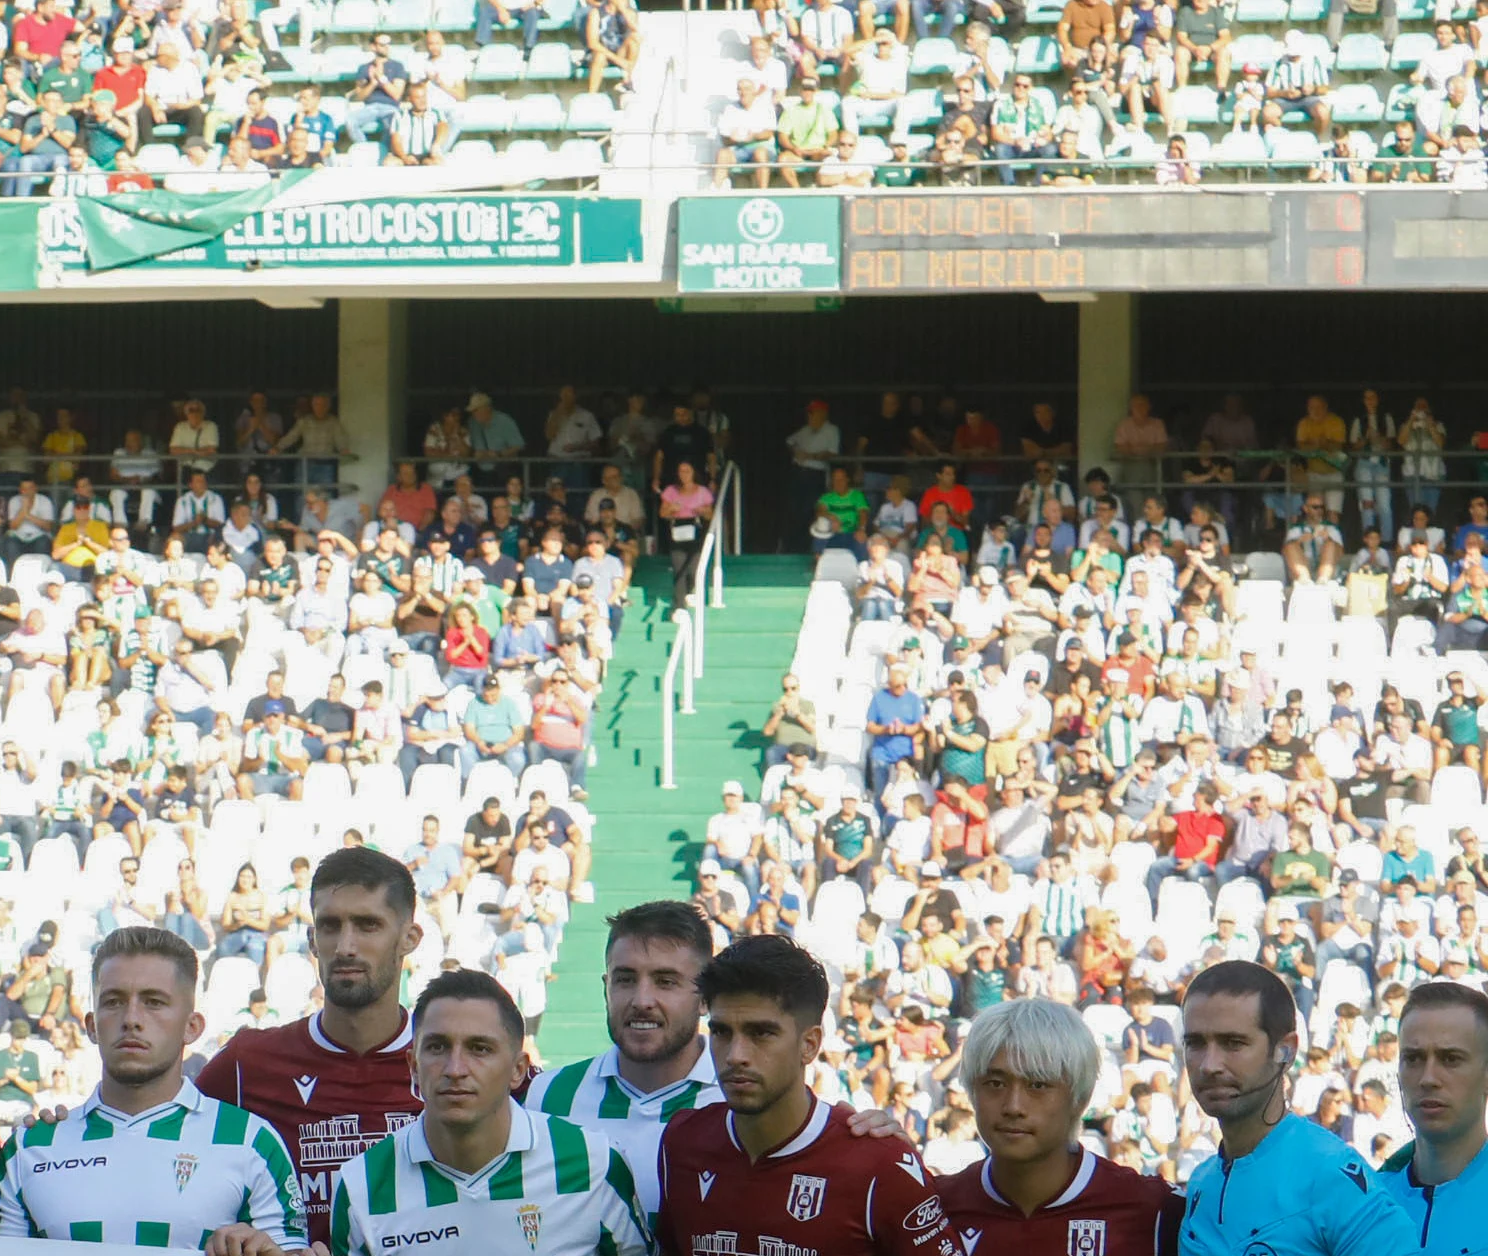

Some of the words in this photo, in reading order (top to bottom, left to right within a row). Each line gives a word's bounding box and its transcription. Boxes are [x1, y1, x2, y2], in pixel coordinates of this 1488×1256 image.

[683, 244, 734, 265] SAN
[738, 243, 836, 266] RAFAEL
[714, 266, 802, 289] MOTOR
[927, 250, 1086, 288] MERIDA
[32, 1157, 108, 1174] GIVOVA
[381, 1226, 460, 1248] GIVOVA
